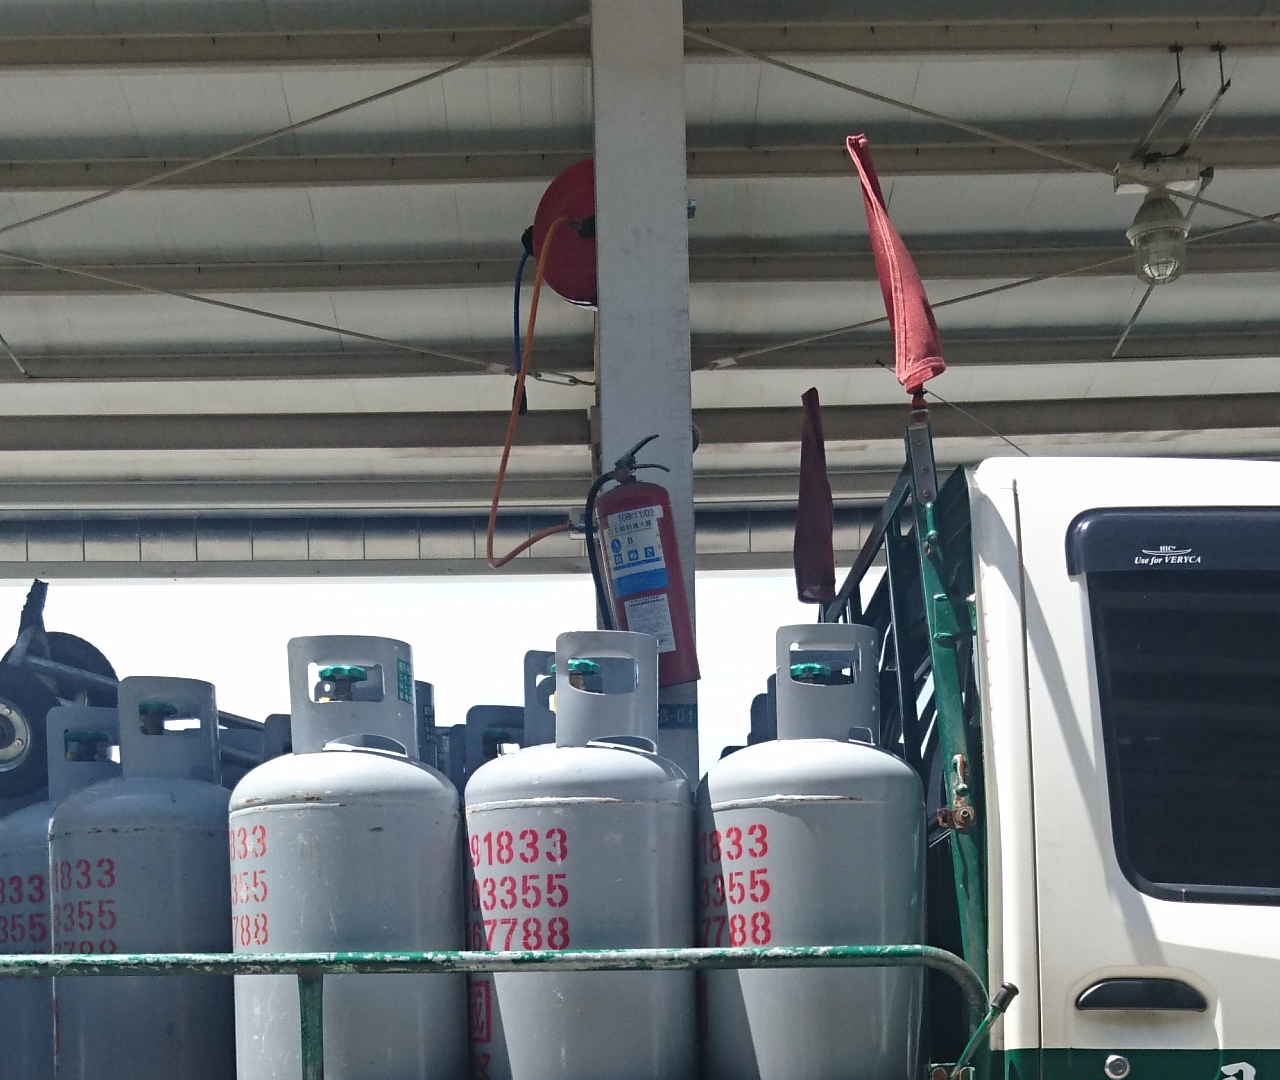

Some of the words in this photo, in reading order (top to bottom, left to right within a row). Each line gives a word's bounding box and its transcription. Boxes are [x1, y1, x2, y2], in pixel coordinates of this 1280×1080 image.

[1134, 556, 1149, 565] Use
[1149, 556, 1163, 566] for
[1164, 555, 1201, 564] VERYCA
